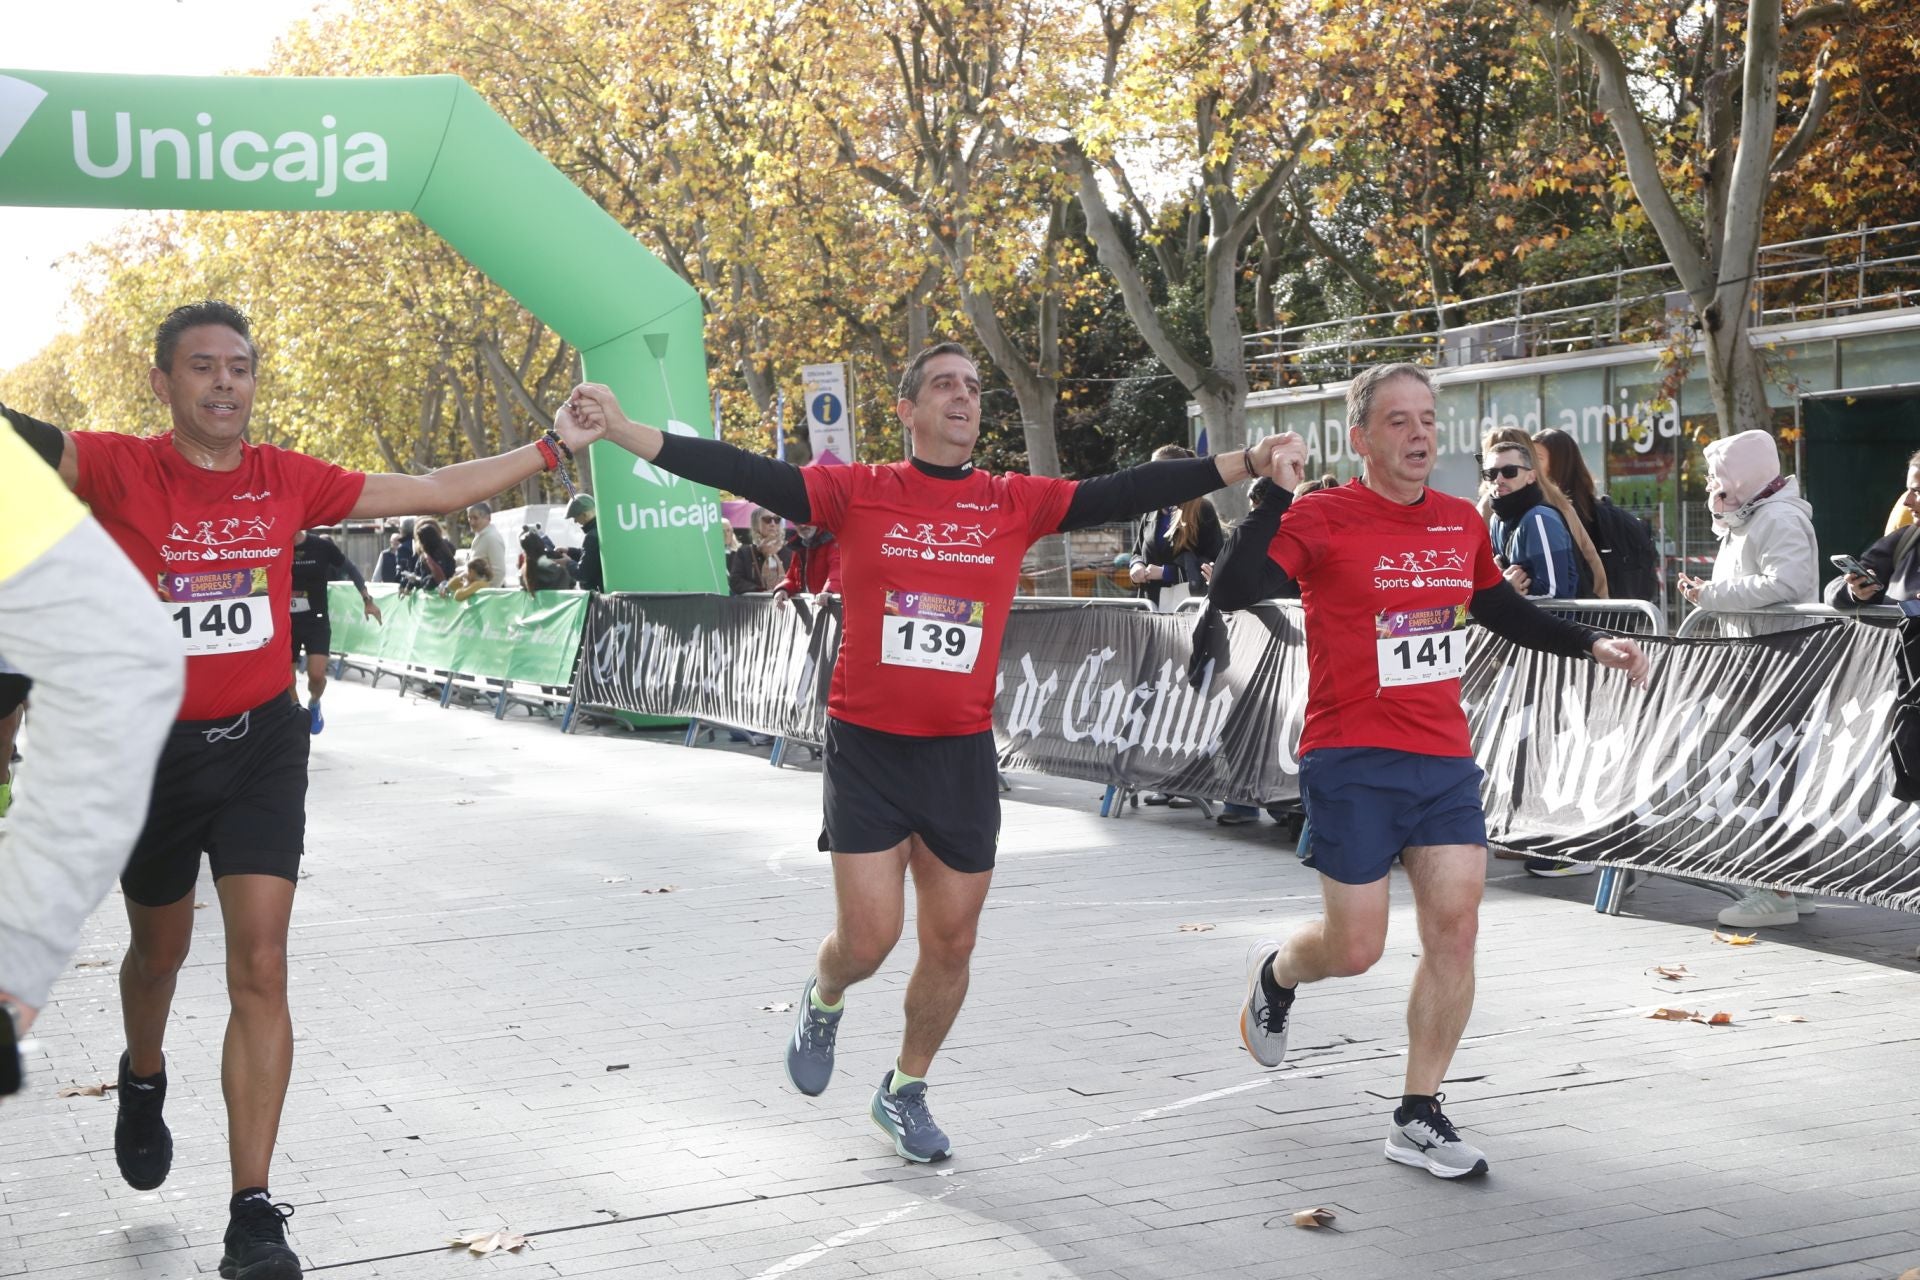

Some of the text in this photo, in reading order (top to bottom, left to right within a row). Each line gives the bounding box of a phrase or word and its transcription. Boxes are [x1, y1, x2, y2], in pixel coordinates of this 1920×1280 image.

[71, 109, 389, 198] Unicaja
[1558, 387, 1682, 453] amiga
[617, 496, 718, 532] Unicaja
[956, 502, 979, 510] Castilla
[160, 544, 282, 562] Sports Santander
[881, 543, 995, 565] Sports Santander
[174, 577, 189, 592] 9ª
[191, 574, 220, 584] CARRERA
[191, 580, 232, 592] EMPRESAS
[1374, 577, 1410, 590] Sports
[905, 594, 919, 608] 9ª
[919, 594, 947, 605] CARRERA
[918, 601, 956, 614] EMPRESAS
[172, 602, 252, 638] 140
[1396, 609, 1442, 628] 9ª CARRERA DE
[1408, 616, 1442, 627] EMPRESAS
[897, 620, 966, 657] 139
[1393, 635, 1451, 669] 141
[1006, 651, 1058, 740] de
[1062, 645, 1235, 760] Castilla
[1542, 685, 1626, 824] de
[1633, 690, 1920, 851] Castill
